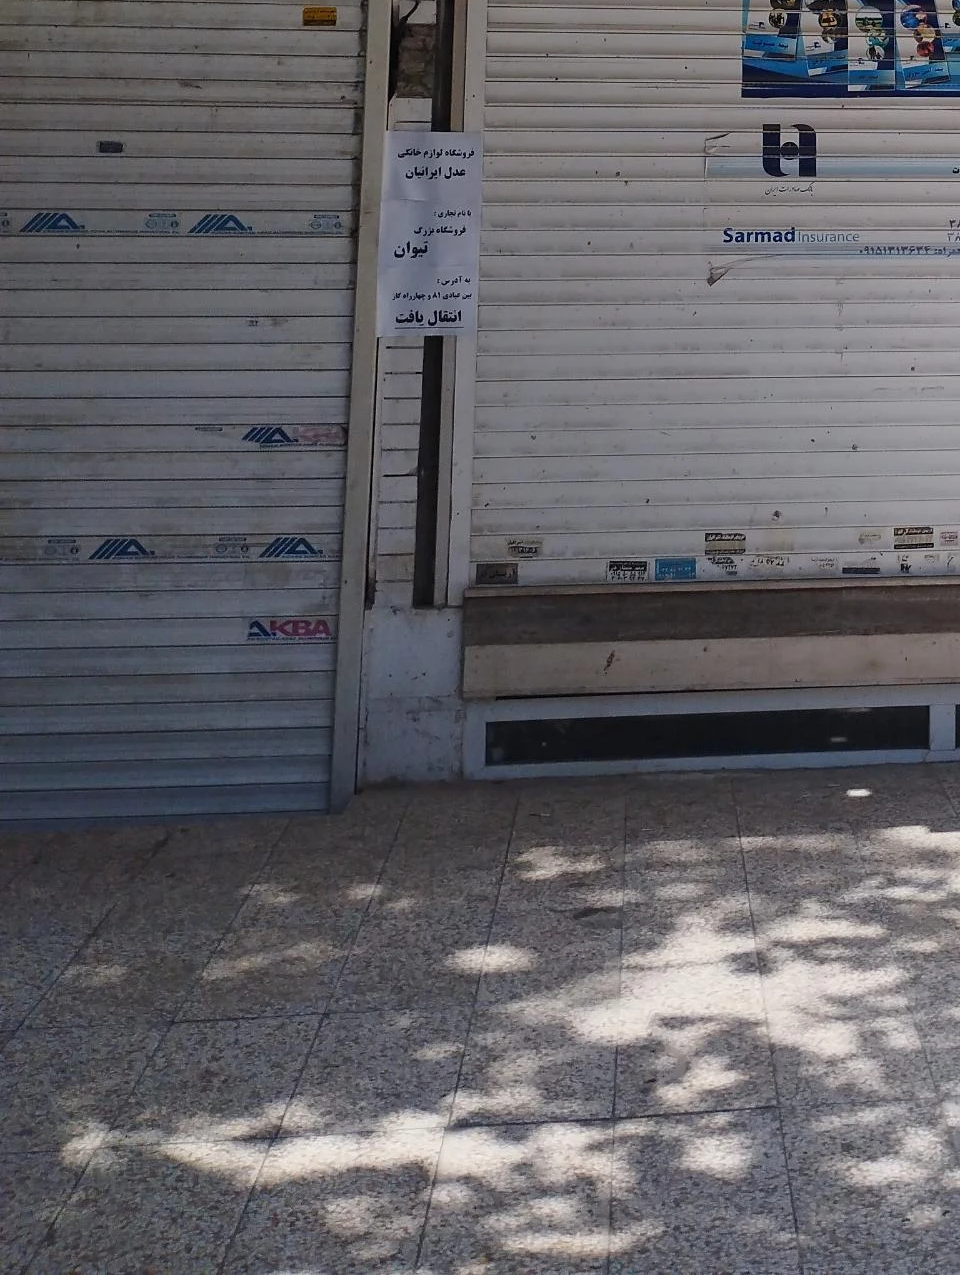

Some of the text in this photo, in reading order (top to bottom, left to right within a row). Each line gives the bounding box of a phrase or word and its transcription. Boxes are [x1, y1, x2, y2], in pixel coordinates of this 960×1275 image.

[423, 148, 443, 159] لوازم
[445, 147, 475, 159] فروشگاه
[405, 166, 466, 179] عدل ایرانیان
[436, 225, 466, 236] فروشگاه
[723, 227, 860, 244] Sarmad Insurance
[859, 246, 931, 256] ۰۹۱۵۱۳۱۳۶۳۴
[395, 309, 462, 326] انتقال یافت
